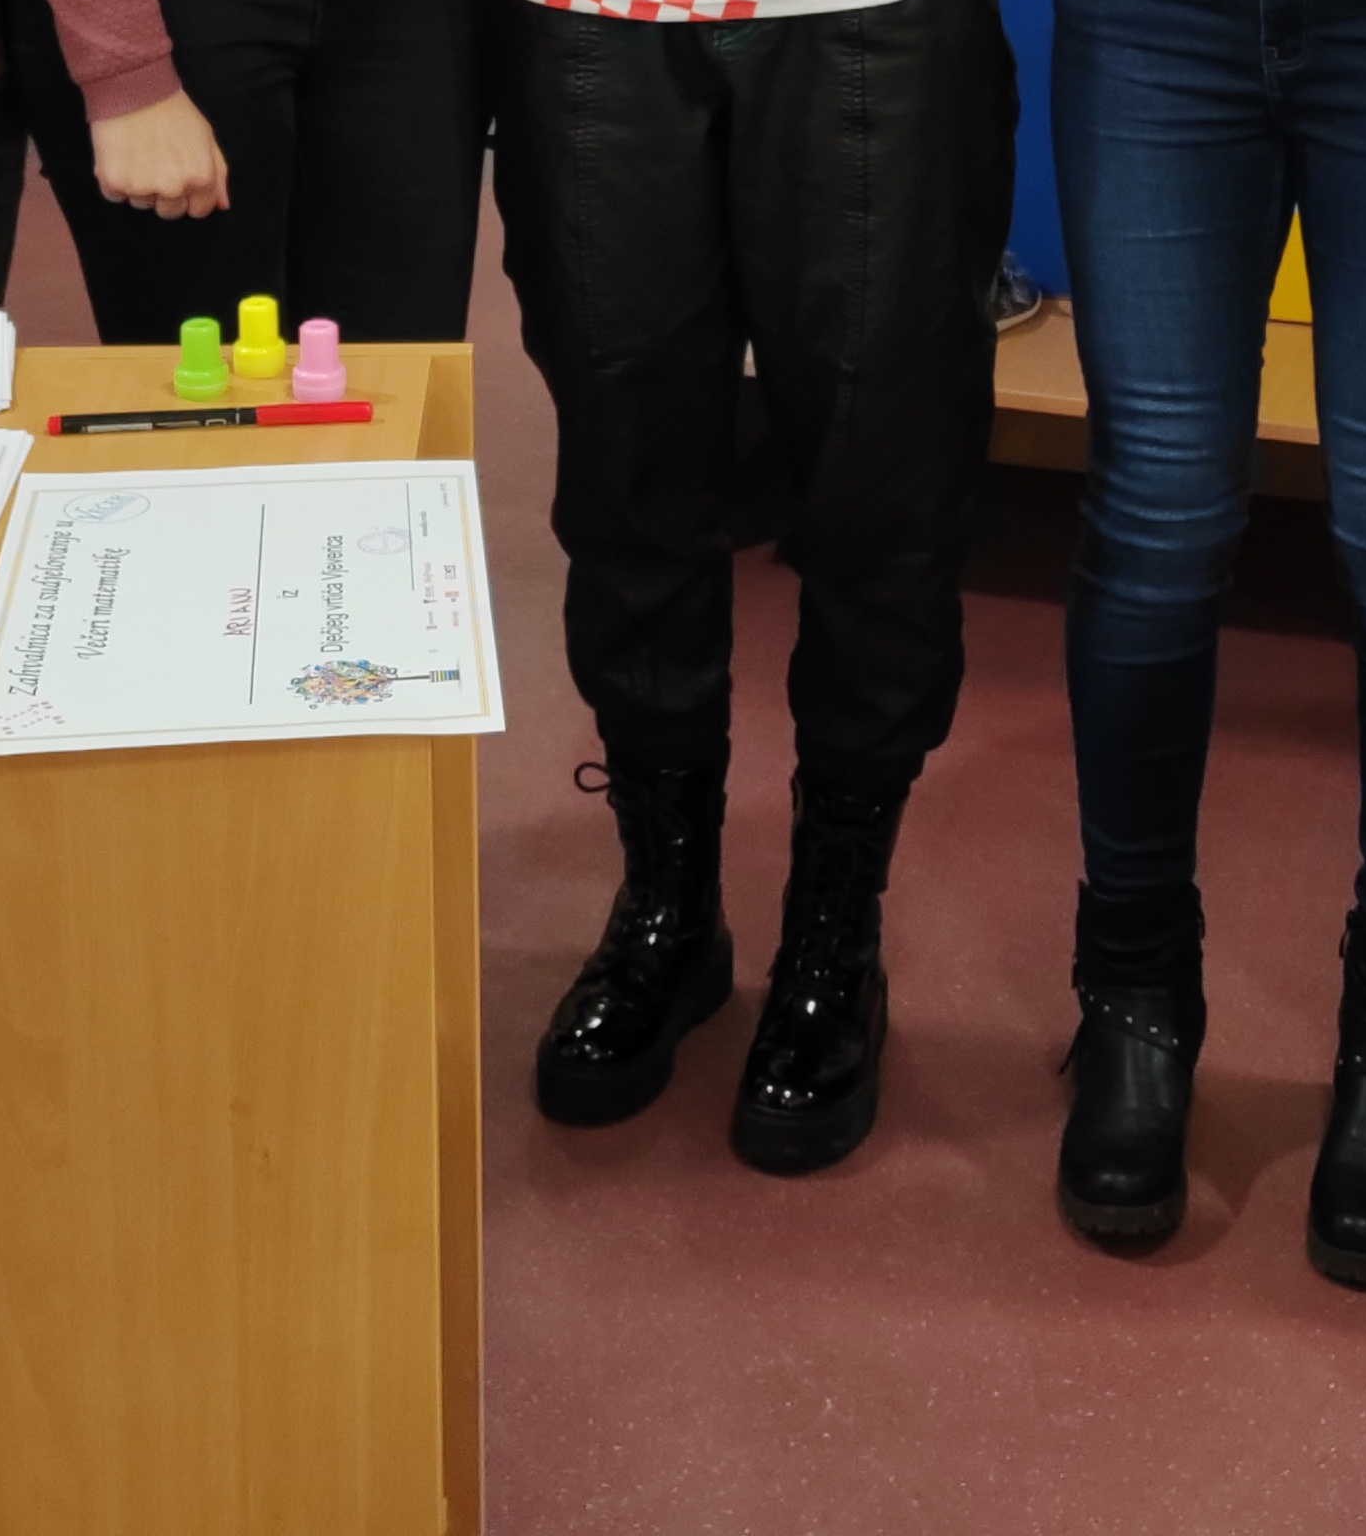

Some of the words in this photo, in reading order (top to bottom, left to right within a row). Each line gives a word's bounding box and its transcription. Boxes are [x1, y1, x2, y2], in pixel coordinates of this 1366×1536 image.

[55, 519, 74, 528] u
[30, 530, 81, 602] sudjelovanje
[321, 534, 349, 582] Vjeverica
[34, 605, 55, 621] za
[73, 619, 111, 660] Večeri
[92, 546, 131, 616] matematike
[276, 588, 299, 600] iz
[321, 582, 344, 612] vrtića
[320, 613, 349, 653] Dječjeg
[8, 623, 52, 697] Zahvalnica
